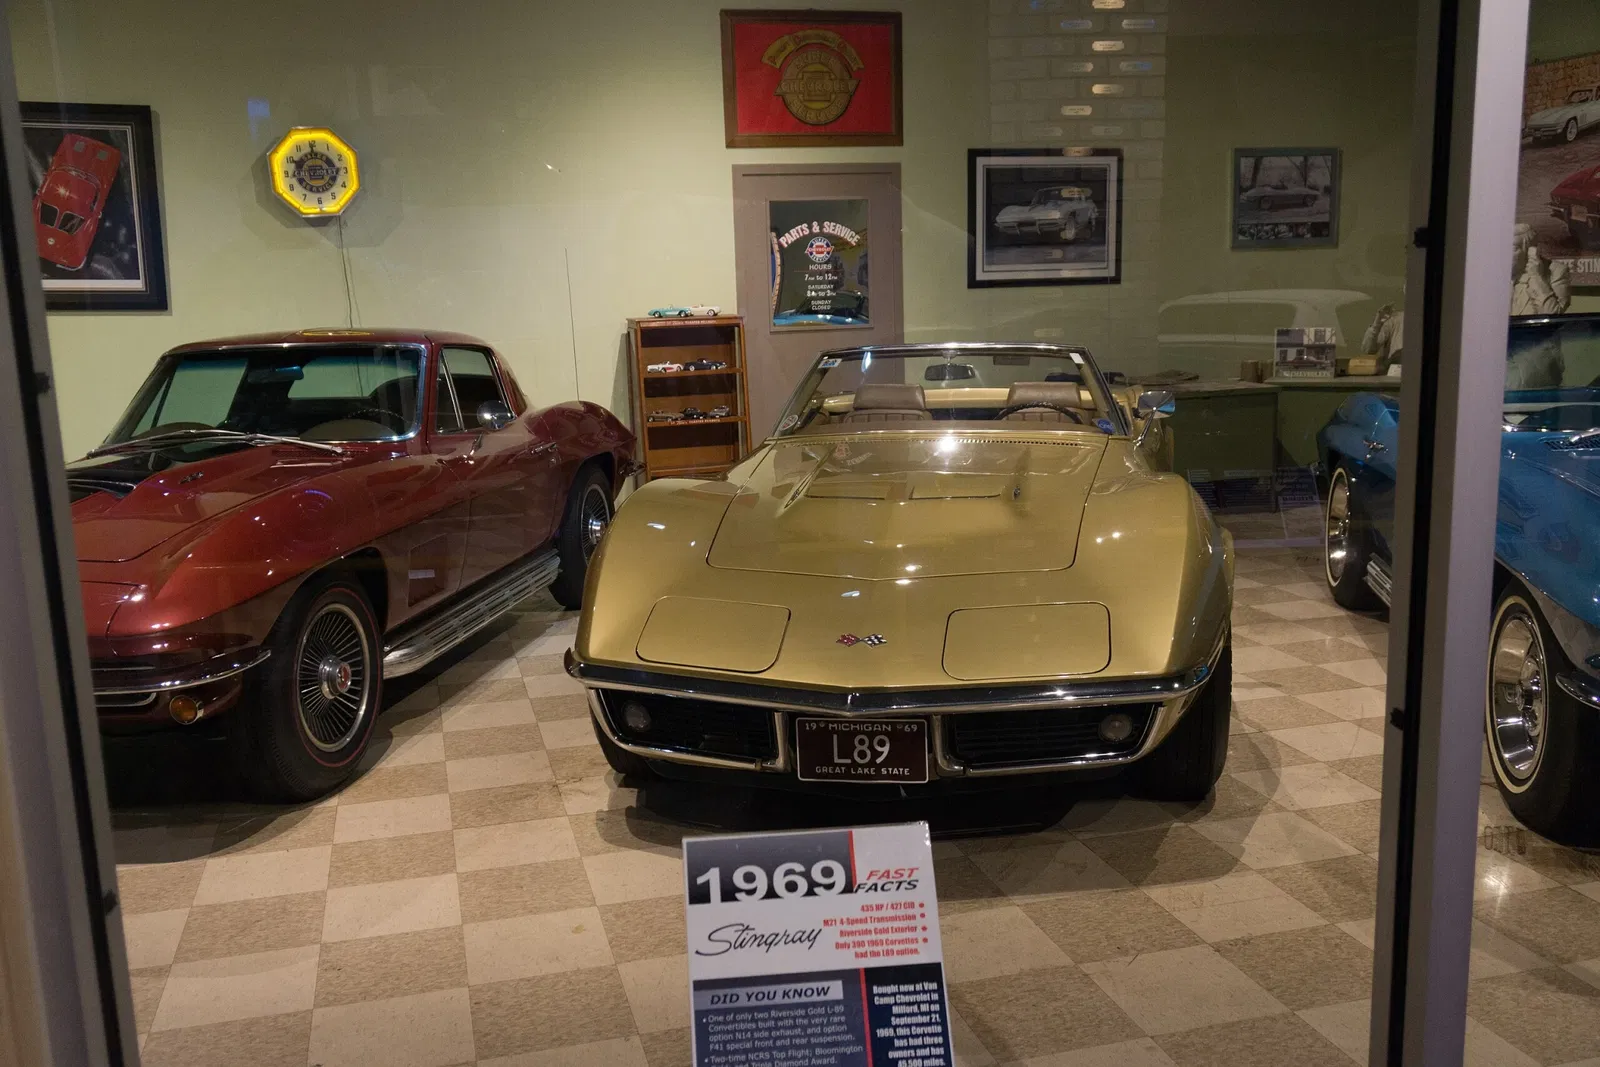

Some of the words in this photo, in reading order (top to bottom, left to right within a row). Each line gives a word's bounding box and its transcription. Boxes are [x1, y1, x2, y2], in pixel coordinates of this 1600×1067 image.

[780, 80, 857, 92] CHEVROLET
[296, 144, 302, 153] 11
[337, 154, 343, 162] 2
[778, 222, 810, 248] PARTS
[812, 221, 820, 233] &
[822, 221, 861, 246] SERVICE
[828, 723, 892, 732] MICHIGAN
[904, 724, 918, 732] 69
[833, 734, 890, 764] L89
[816, 766, 846, 774] GREAT
[851, 767, 876, 775] LAKE
[866, 867, 919, 880] FAST
[696, 860, 846, 904] 1969
[854, 880, 919, 894] FACTS
[890, 902, 902, 910] 427
[903, 902, 915, 910] CID
[823, 919, 837, 927] M21
[840, 916, 868, 926] 4-Speed
[869, 914, 916, 924] Transmission
[839, 929, 872, 937] Riverside
[874, 927, 889, 935] Gold
[891, 925, 917, 934] Exterior
[695, 923, 822, 956] Stingray
[867, 939, 884, 947] 1969
[885, 937, 919, 946] Corvettes
[882, 949, 894, 957] L89
[896, 948, 920, 956] option.
[710, 993, 740, 1005] DID
[746, 990, 777, 1002] YOU
[782, 986, 830, 1000] KNOW
[873, 985, 899, 994] Bought
[874, 996, 895, 1005] Camp
[896, 994, 930, 1003] Chevrolet
[708, 1015, 724, 1023] One
[726, 1012, 733, 1021] of
[736, 1012, 752, 1021] only
[770, 1009, 805, 1018] Riverside
[808, 1007, 825, 1015] Gold
[828, 1005, 844, 1014] L-89
[892, 1005, 919, 1014] Milford,
[920, 1003, 929, 1012] MI
[708, 1023, 756, 1032] Convertibles
[758, 1020, 775, 1028] built
[891, 1015, 930, 1026] September
[709, 1034, 733, 1042] option
[771, 1028, 804, 1037] exhaust,
[823, 1024, 847, 1033] option
[896, 1027, 910, 1036] this
[911, 1025, 942, 1034] Corvette
[726, 1041, 753, 1050] special
[754, 1039, 774, 1047] front
[810, 1034, 855, 1044] suspension.
[894, 1038, 908, 1047] has
[909, 1037, 922, 1045] had
[924, 1036, 943, 1044] three
[710, 1055, 746, 1064] Two-time
[748, 1052, 770, 1060] NCRS
[772, 1051, 786, 1059] Top
[815, 1046, 863, 1055] Bloomington
[888, 1050, 915, 1059] owners
[916, 1048, 930, 1056] and
[931, 1047, 944, 1055] has
[775, 1059, 809, 1067] Diamond
[811, 1056, 837, 1065] Award.
[923, 1058, 946, 1067] miles.
